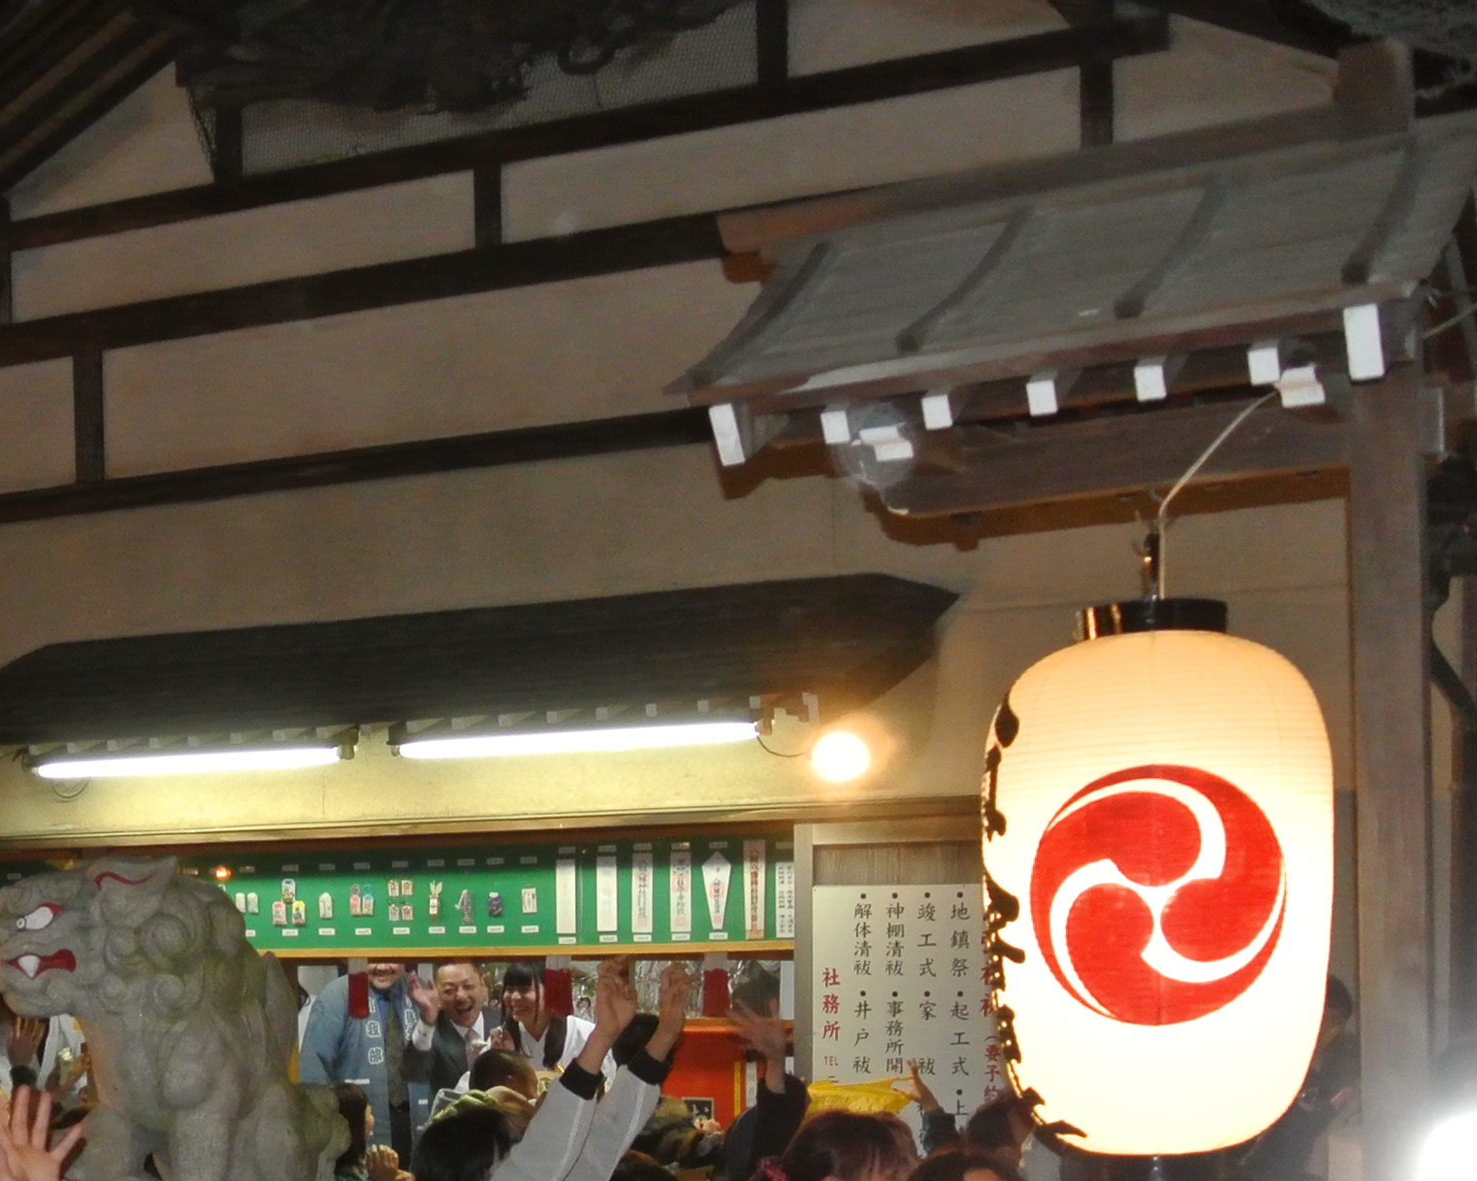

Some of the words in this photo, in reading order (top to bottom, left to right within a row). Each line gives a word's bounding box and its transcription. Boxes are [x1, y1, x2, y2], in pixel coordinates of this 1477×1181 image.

[853, 902, 873, 976] 解体清祓
[885, 902, 905, 977] 神棚清祓
[917, 902, 937, 978] 竣工式
[950, 902, 970, 977] 地鎮祭
[822, 967, 841, 1041] 社務所
[852, 1001, 872, 1074] 井戸祓
[950, 1000, 970, 1076] 起工式
[824, 1056, 839, 1066] TEL
